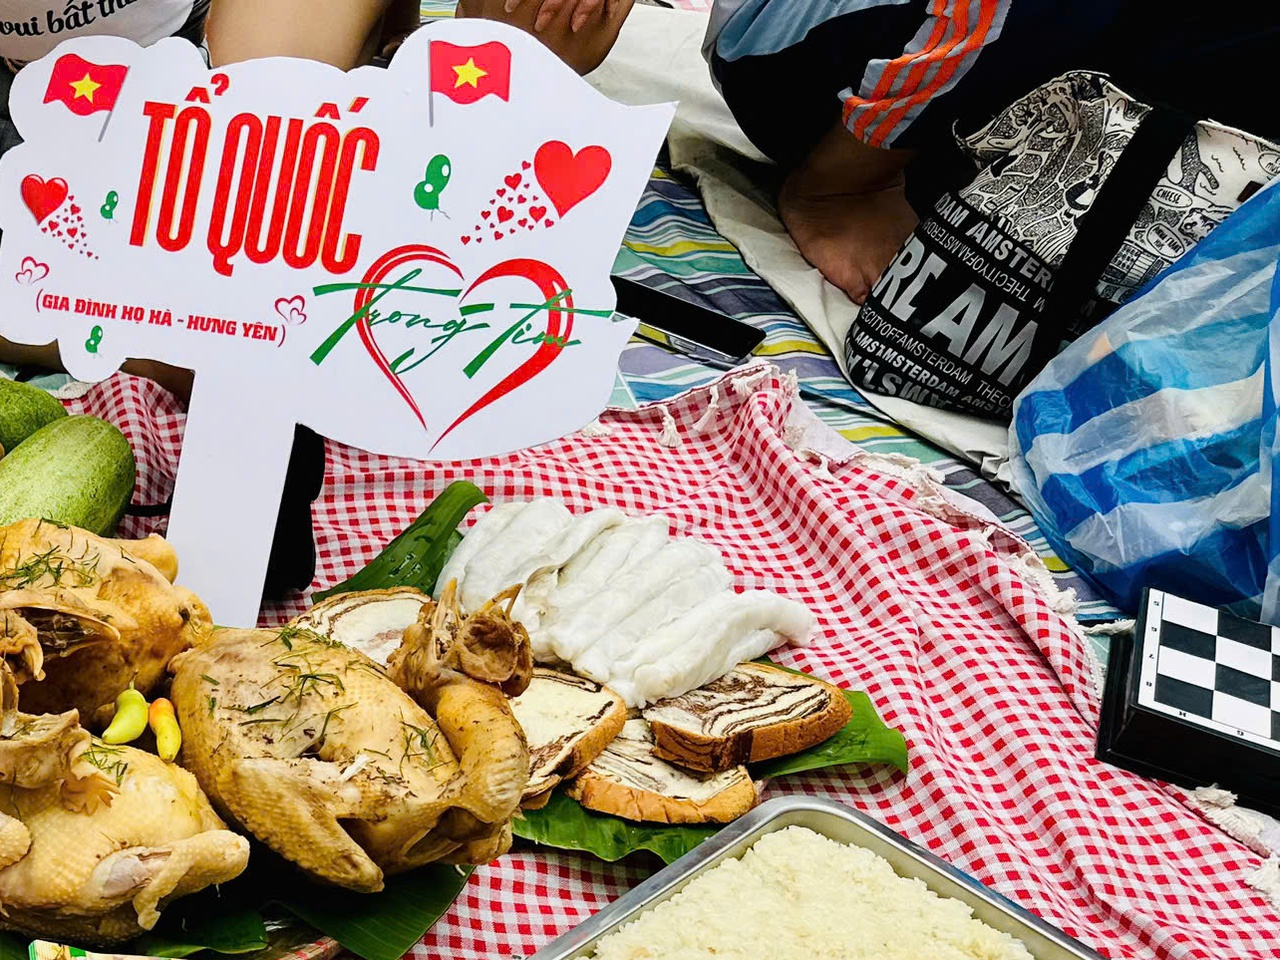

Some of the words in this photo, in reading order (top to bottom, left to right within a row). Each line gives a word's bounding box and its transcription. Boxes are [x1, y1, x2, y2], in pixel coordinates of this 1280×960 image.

[128, 73, 231, 252] TỔ
[206, 96, 380, 277] QUỐC
[1155, 187, 1183, 205] CHEESE
[74, 298, 117, 319] ĐÌNH
[120, 305, 145, 324] HỌ
[148, 308, 173, 327] HÀ
[186, 314, 237, 336] HƯNG
[309, 268, 490, 376] Trong
[462, 288, 614, 380] Tim
